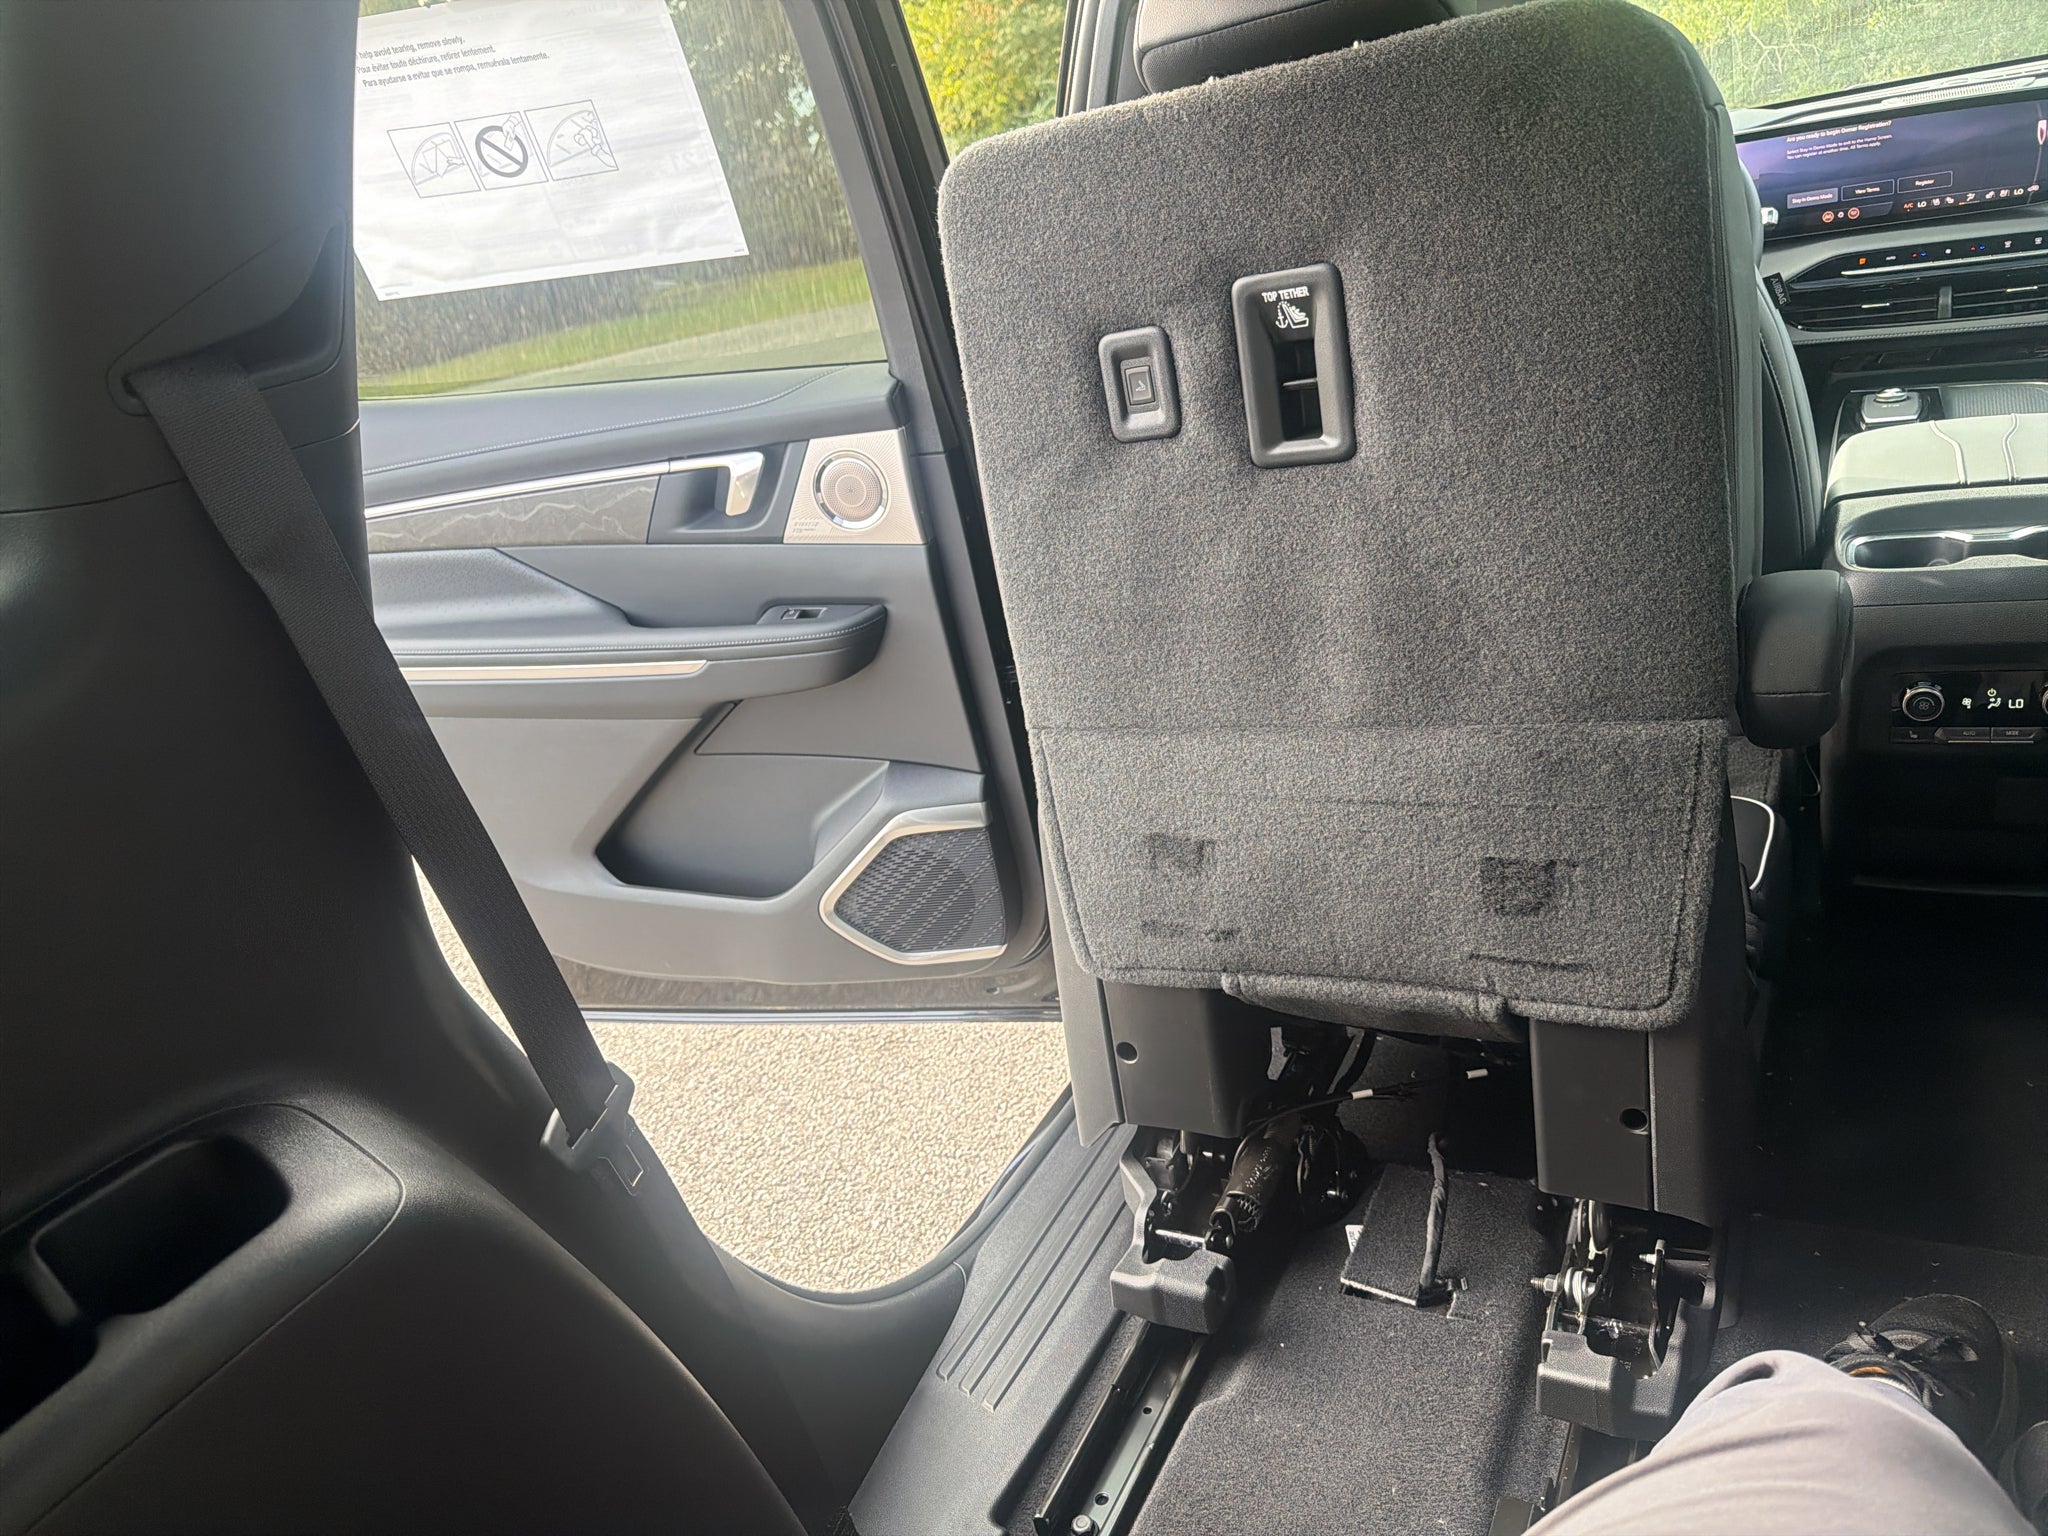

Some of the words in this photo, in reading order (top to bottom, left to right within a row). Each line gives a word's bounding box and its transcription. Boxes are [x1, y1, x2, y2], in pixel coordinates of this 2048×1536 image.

[359, 50, 373, 60] help
[374, 46, 391, 57] avoid
[391, 43, 417, 54] tearing,
[417, 40, 442, 50] remove
[441, 35, 466, 47] slowly.
[390, 59, 408, 69] toute
[408, 54, 441, 67] déchirure,
[440, 51, 461, 62] retirer
[461, 45, 497, 58] lentement.
[362, 77, 378, 88] Para
[378, 74, 407, 87] ayudarse
[413, 70, 431, 80] evitar
[431, 69, 444, 79] que
[445, 67, 453, 75] se
[453, 64, 478, 75] rompa,
[477, 57, 511, 70] remuévala
[511, 51, 550, 66] lentamente.
[1806, 132, 1820, 140] ready
[1826, 129, 1840, 137] begin
[1841, 126, 1858, 134] Owner
[1858, 119, 1892, 131] Registration?
[1915, 178, 1935, 187] Register
[2013, 188, 2025, 196] LO
[1903, 202, 1914, 210] A/C
[1917, 200, 1928, 208] LO
[1261, 290, 1278, 303] TOP
[1278, 285, 1310, 300] TETHER
[1770, 278, 1787, 305] AIRBAG
[2008, 698, 2025, 709] LO
